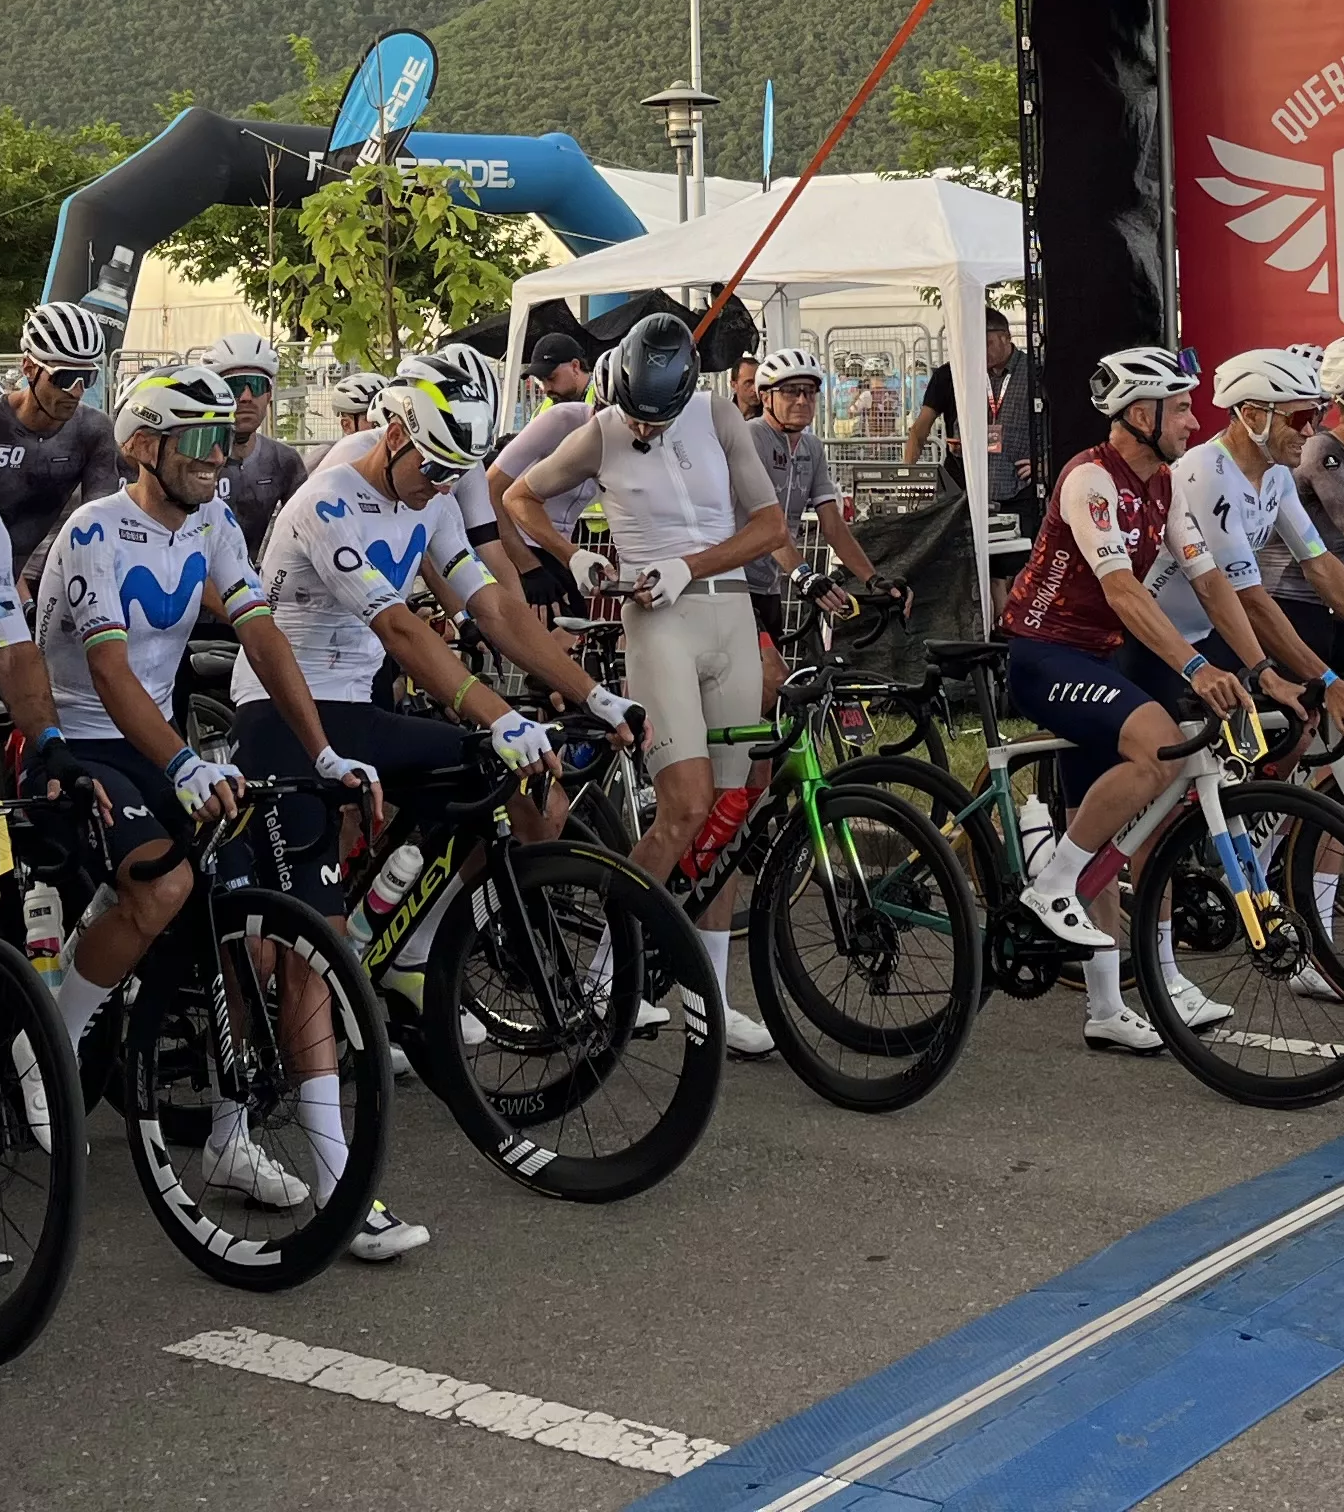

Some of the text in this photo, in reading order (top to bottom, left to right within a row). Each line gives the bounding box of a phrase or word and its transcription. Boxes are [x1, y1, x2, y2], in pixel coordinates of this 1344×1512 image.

[1024, 549, 1071, 630] SABIÑÁNIGO
[1047, 682, 1121, 705] CYCLON
[361, 835, 456, 978] RIDLEY
[211, 972, 235, 1076] CANYON
[498, 1092, 545, 1116] SWISS
